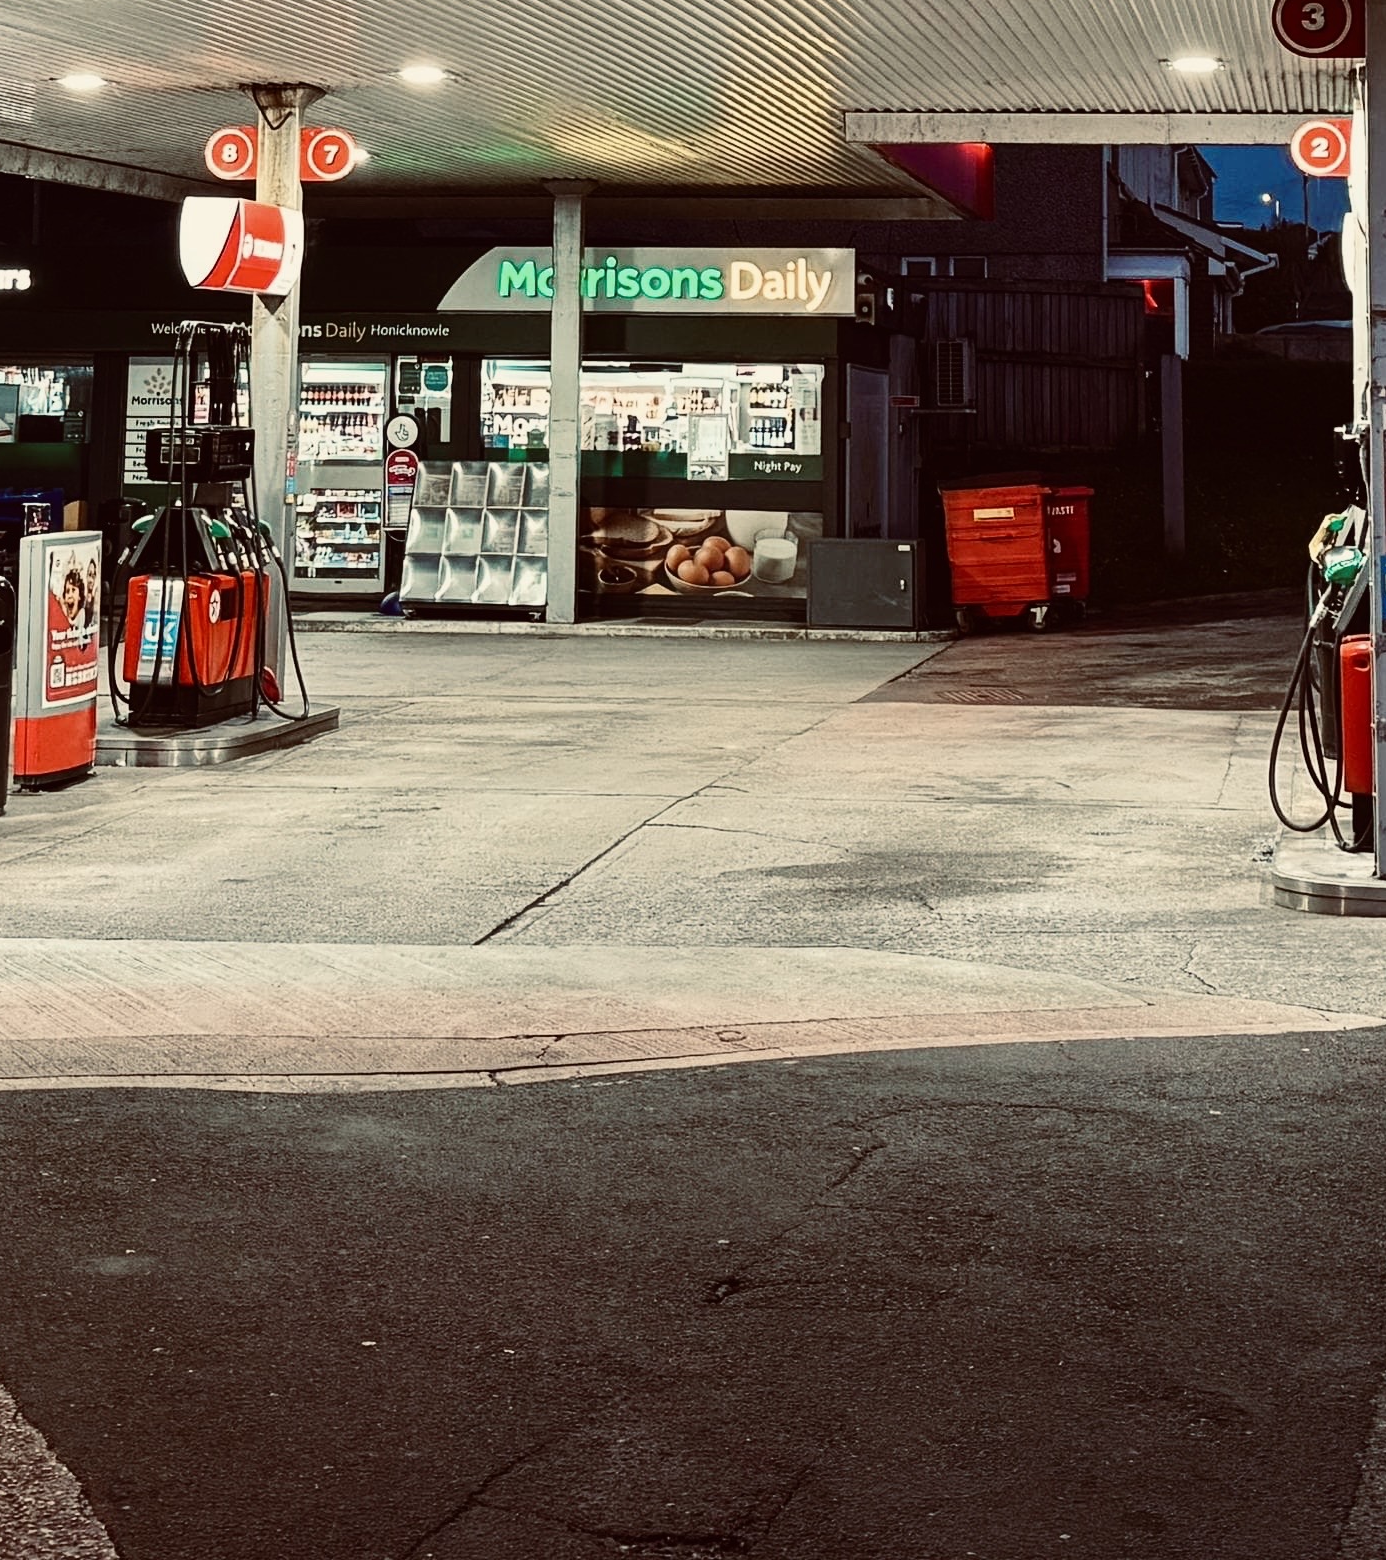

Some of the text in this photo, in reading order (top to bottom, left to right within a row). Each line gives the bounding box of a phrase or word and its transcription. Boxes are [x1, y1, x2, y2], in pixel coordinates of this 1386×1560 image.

[1301, 2, 1325, 31] 3
[221, 143, 238, 163] 8
[323, 145, 340, 164] 7
[1310, 137, 1330, 158] 2
[499, 256, 832, 311] Morisons Daily
[325, 322, 366, 343] Daily
[370, 323, 450, 337] Honicknowle
[754, 460, 802, 474] Night Pay
[144, 621, 176, 643] UK
